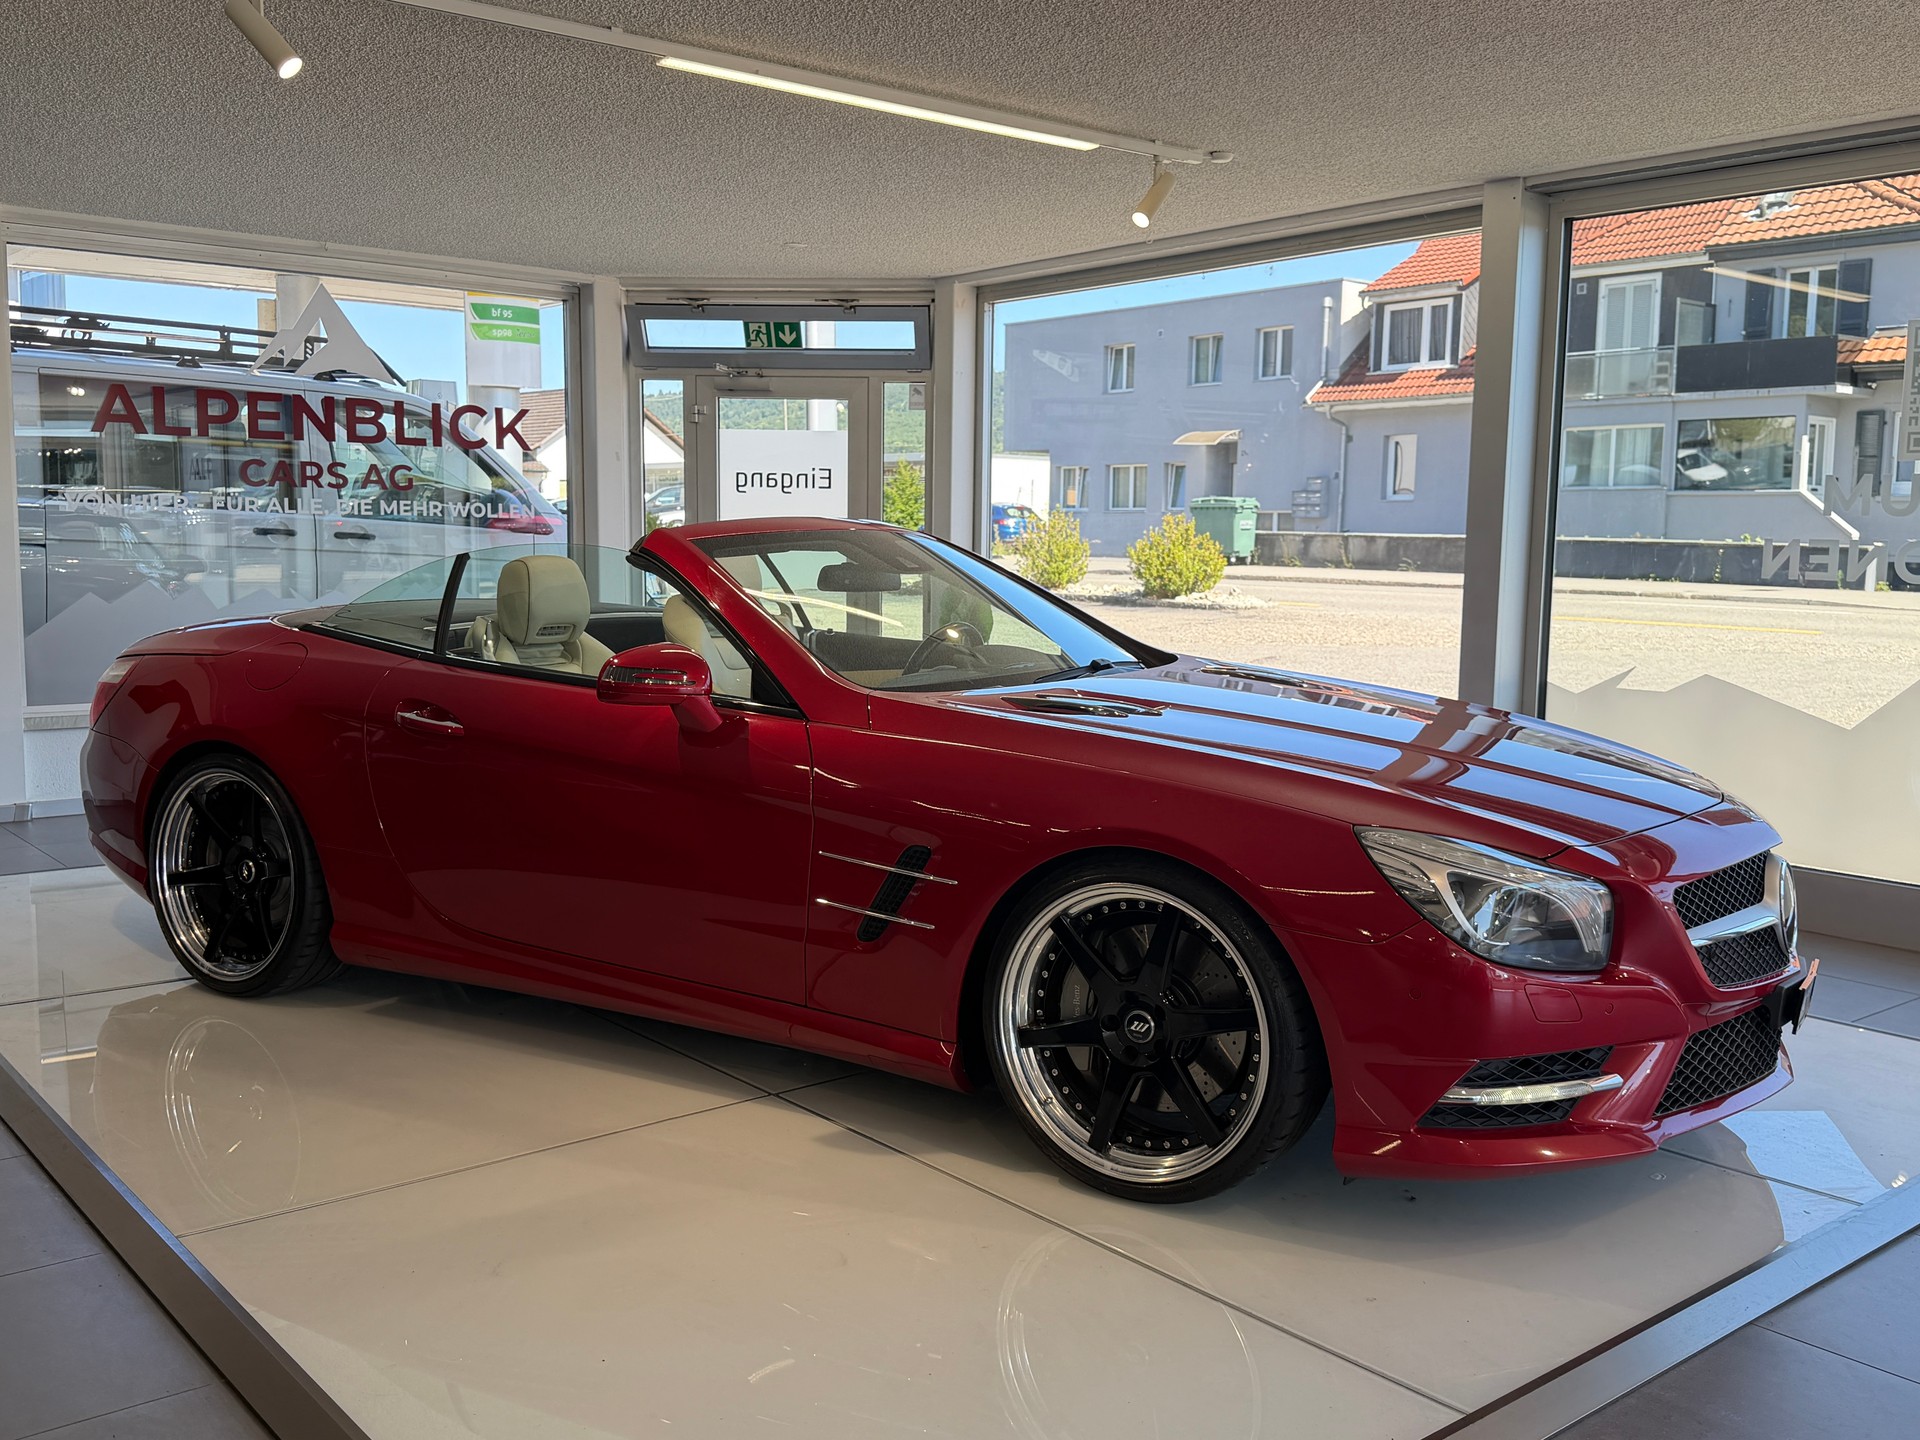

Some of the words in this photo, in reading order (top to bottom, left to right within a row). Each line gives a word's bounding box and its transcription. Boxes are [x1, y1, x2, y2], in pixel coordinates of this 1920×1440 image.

[491, 308, 501, 317] bf
[502, 310, 513, 318] 95
[492, 329, 513, 338] sp98
[91, 383, 532, 451] ALPENBLICK
[240, 459, 349, 489] CARS
[361, 464, 414, 491] AG
[64, 492, 121, 512] VON
[131, 493, 189, 512] HIER
[213, 491, 257, 513] FÜR
[263, 497, 328, 516] ALLE,
[337, 499, 373, 516] DIE
[380, 500, 443, 517] MEHR
[451, 502, 536, 519] WOLLEN
